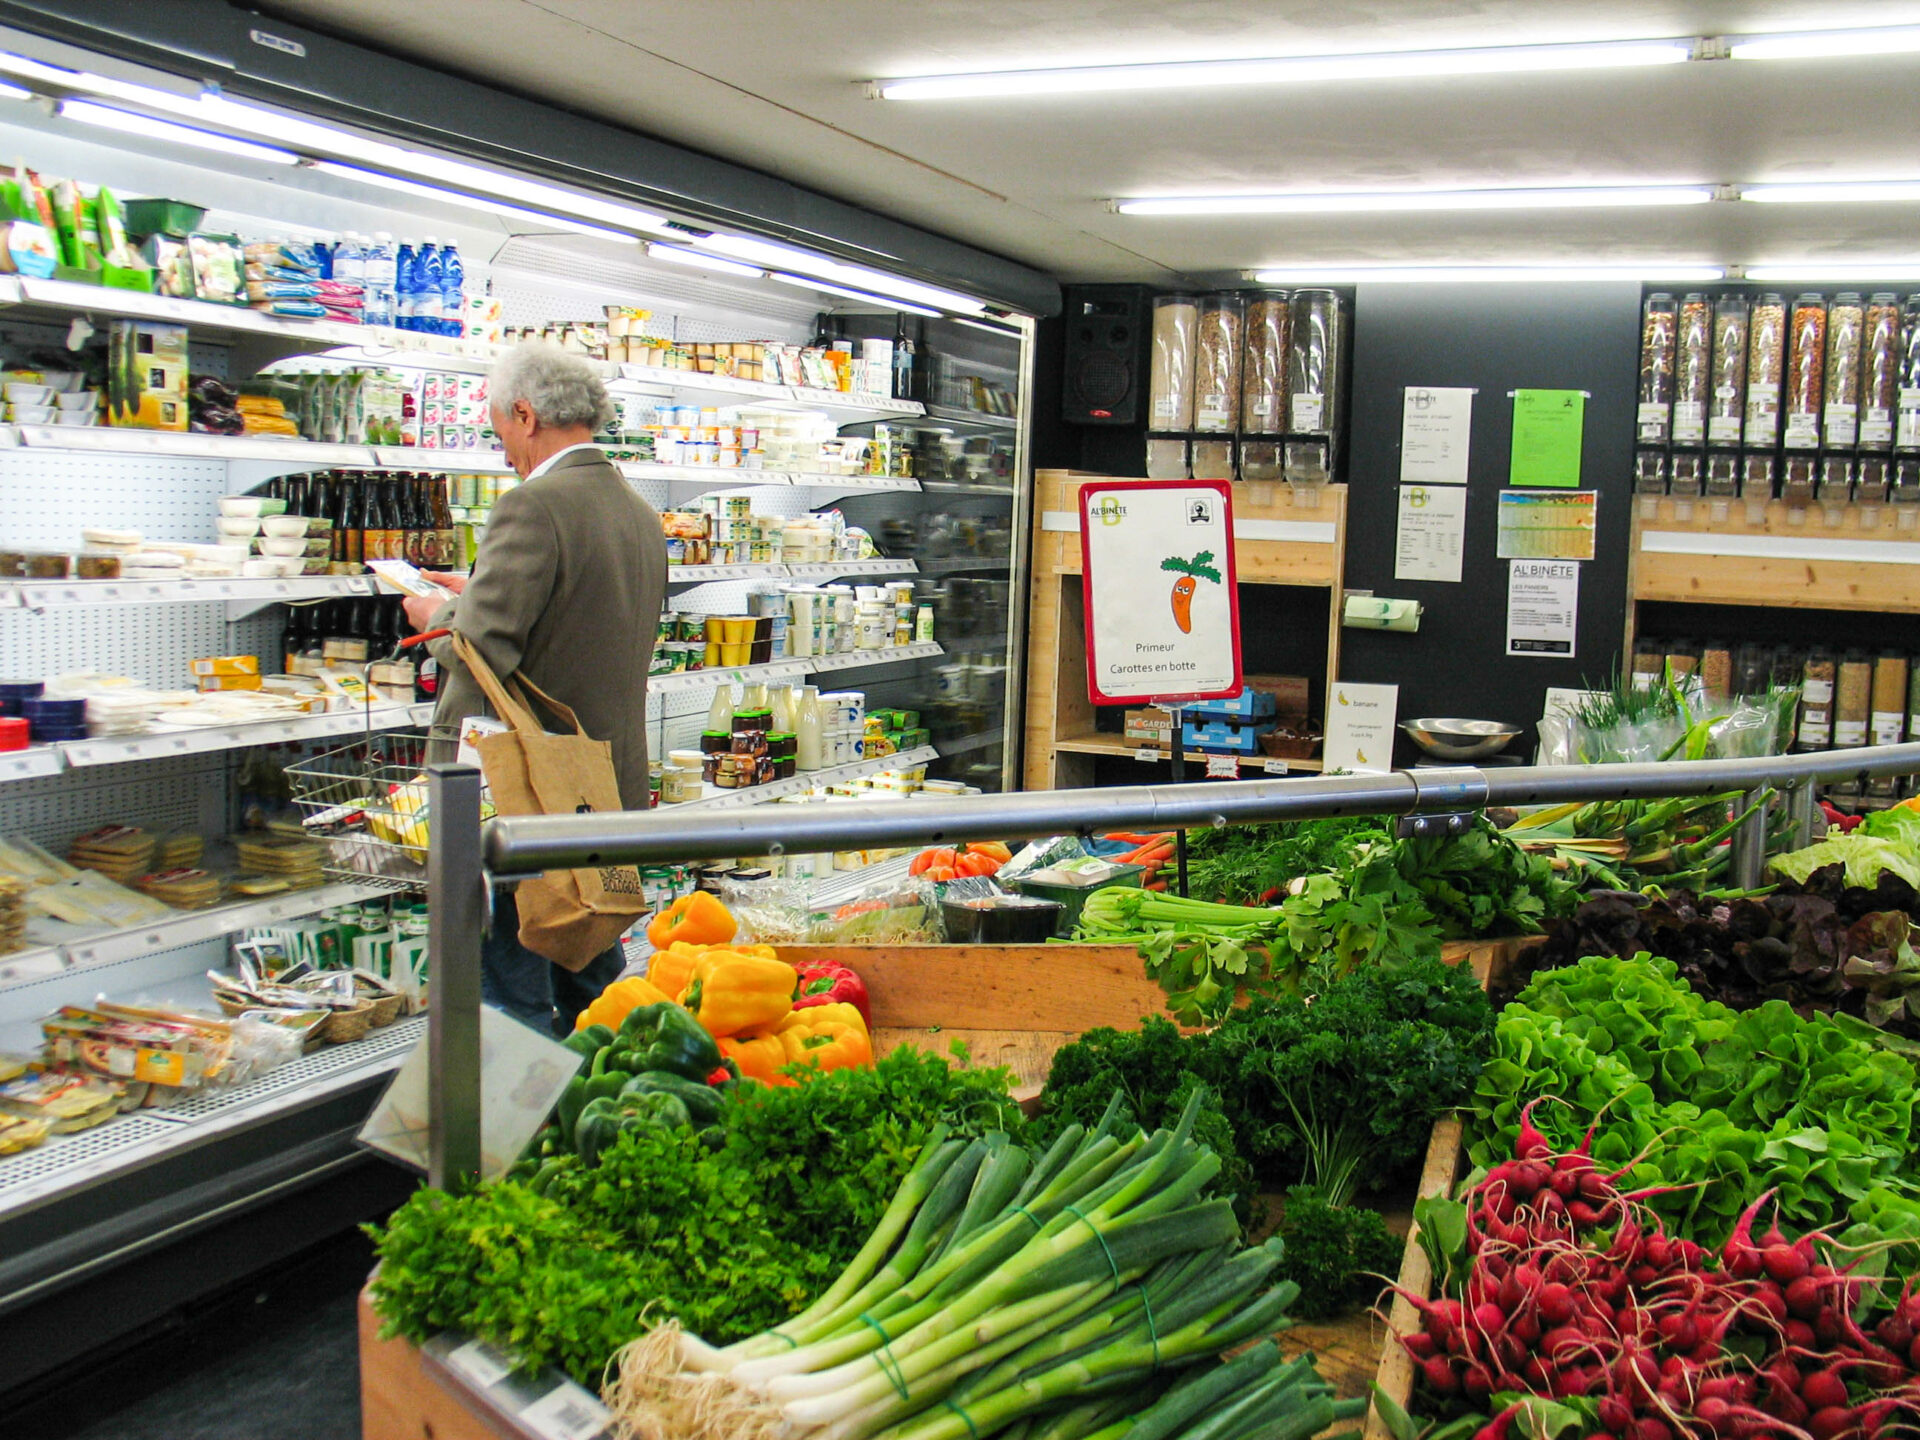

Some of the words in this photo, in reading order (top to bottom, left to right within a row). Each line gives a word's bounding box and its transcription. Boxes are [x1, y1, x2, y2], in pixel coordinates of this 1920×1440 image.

[1136, 643, 1175, 653] Primeur
[1514, 641, 1521, 650] 3
[1110, 662, 1153, 674] Carottes
[1155, 664, 1167, 672] en
[1169, 662, 1196, 671] botte
